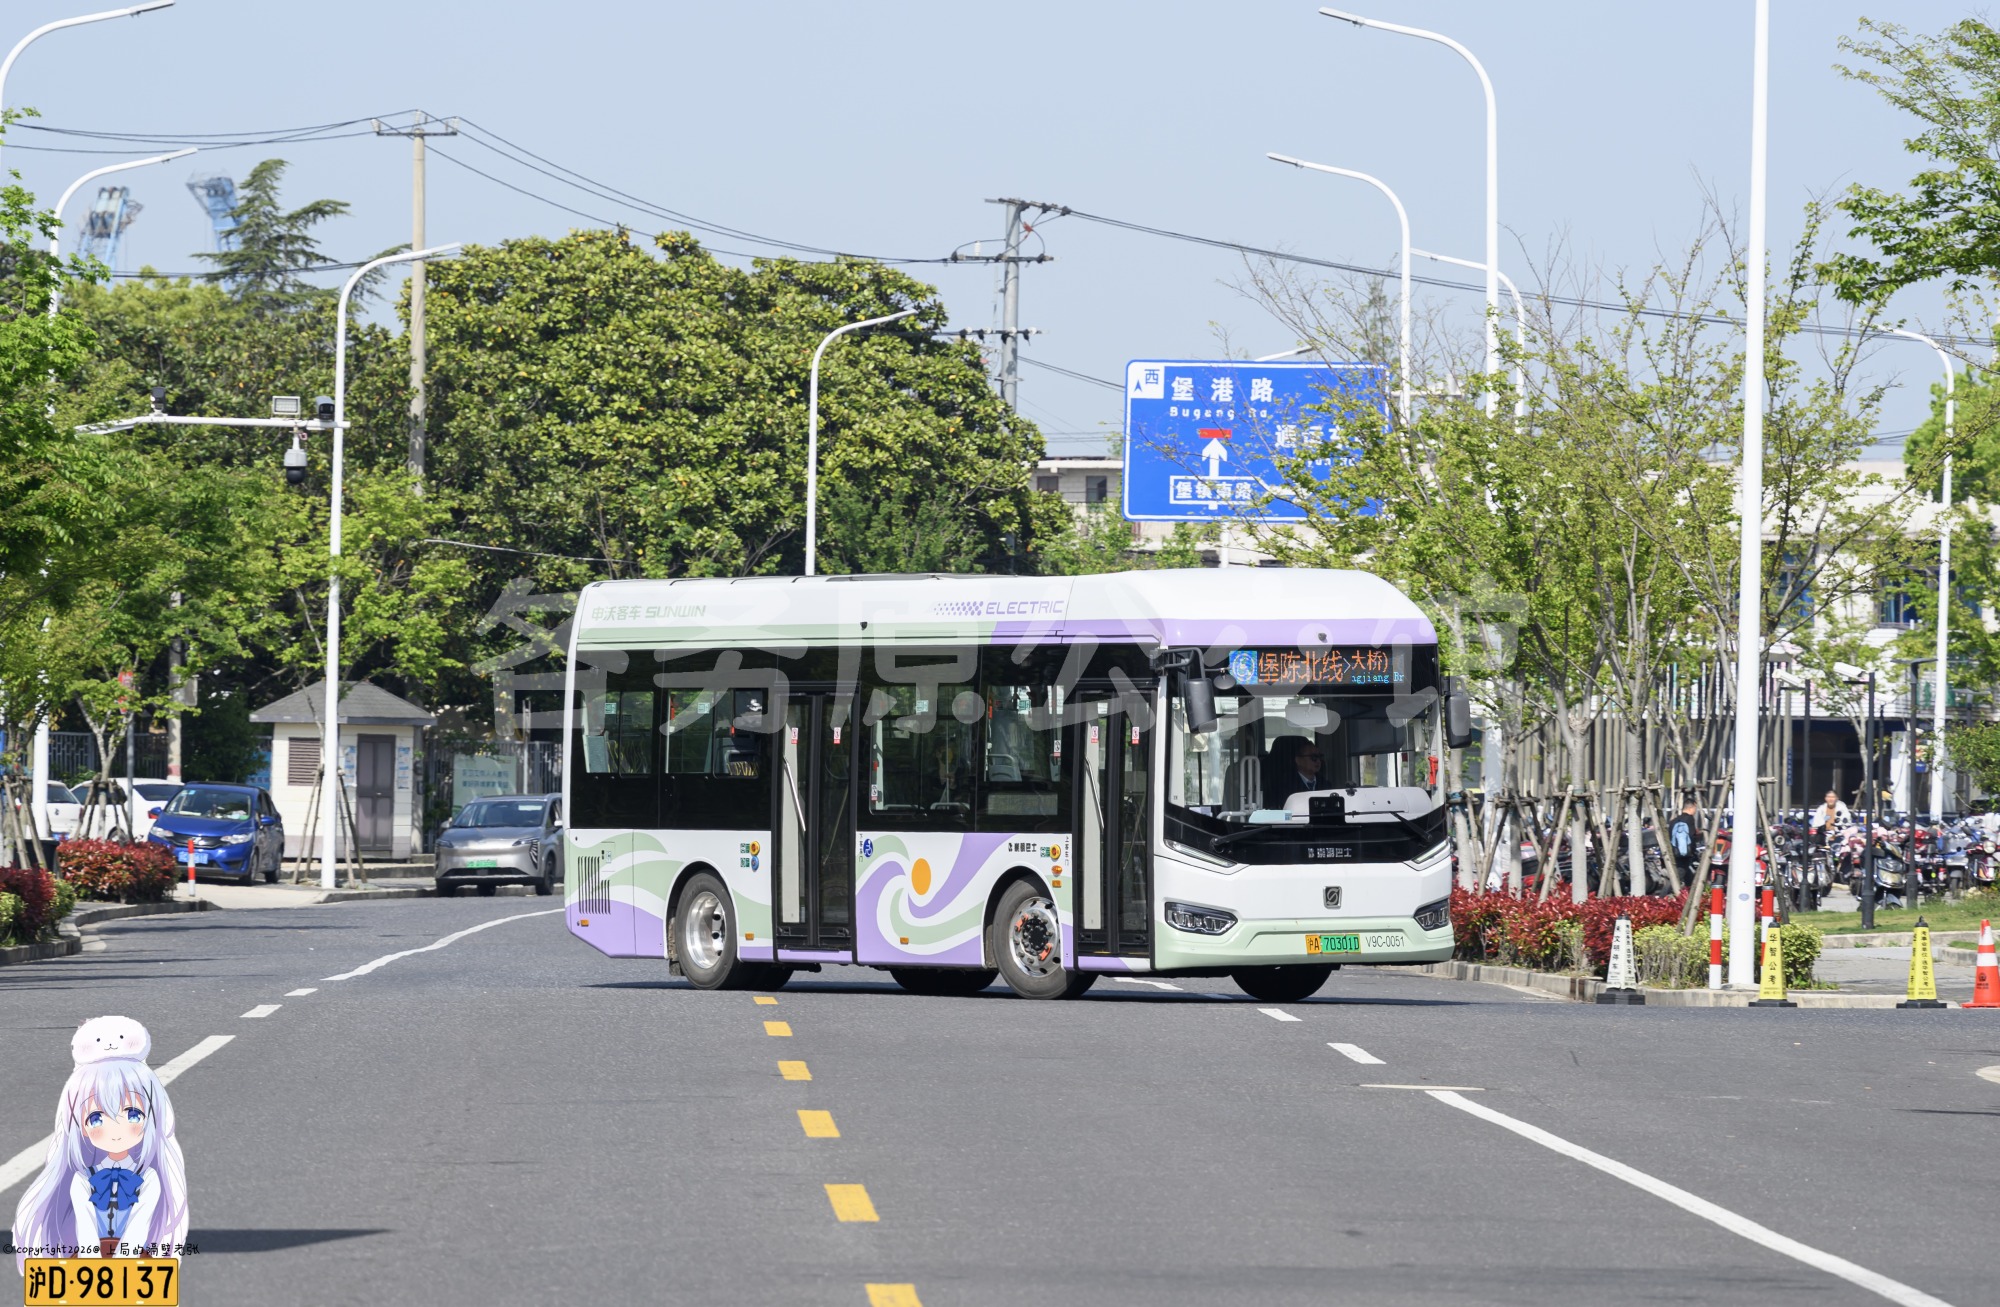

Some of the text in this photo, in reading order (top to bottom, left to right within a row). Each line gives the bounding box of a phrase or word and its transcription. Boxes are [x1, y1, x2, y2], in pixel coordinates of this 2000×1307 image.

[1144, 368, 1160, 385] 西
[1171, 377, 1274, 401] 堡港路
[1169, 406, 1235, 421] Bugang
[1175, 481, 1253, 500] 堡镇南路
[592, 604, 707, 621] 申沃客车 SUNWIN
[985, 600, 1065, 615] ELECTRIC
[1258, 650, 1344, 683] 堡陈北线
[1365, 935, 1405, 948] V9C-0051
[1768, 933, 1778, 984] 华智公考
